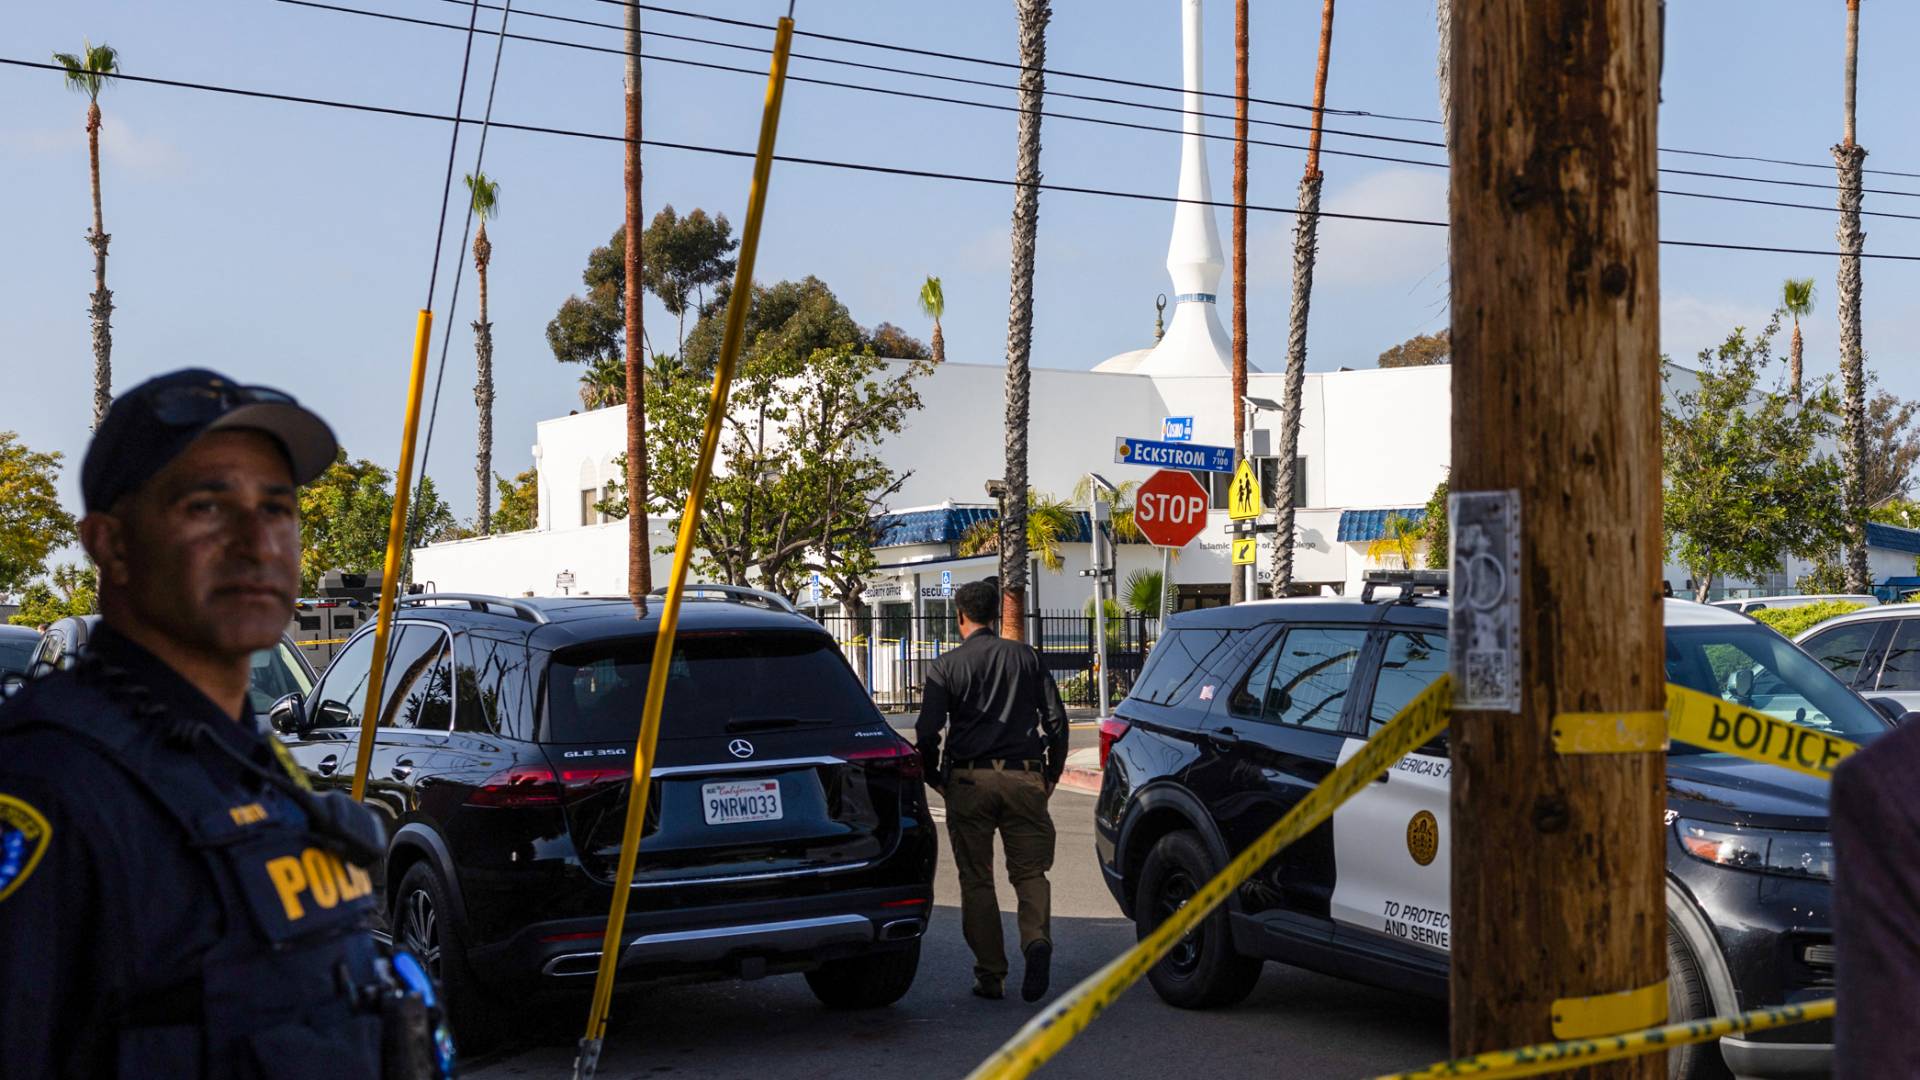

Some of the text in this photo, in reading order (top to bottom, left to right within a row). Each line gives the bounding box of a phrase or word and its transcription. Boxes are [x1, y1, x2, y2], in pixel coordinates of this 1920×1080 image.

[1134, 443, 1205, 466] ECKSTROM
[1216, 449, 1226, 457] AV
[1212, 456, 1229, 466] 7100
[1139, 492, 1204, 525] STOP
[1199, 542, 1230, 550] Islamic
[1262, 542, 1271, 550] of
[921, 587, 960, 598] SECUTY
[564, 748, 627, 758] GLE 350
[710, 795, 777, 819] 9NRW033
[1384, 900, 1450, 929] TO PROTEC
[1384, 919, 1449, 948] AND SERVE
